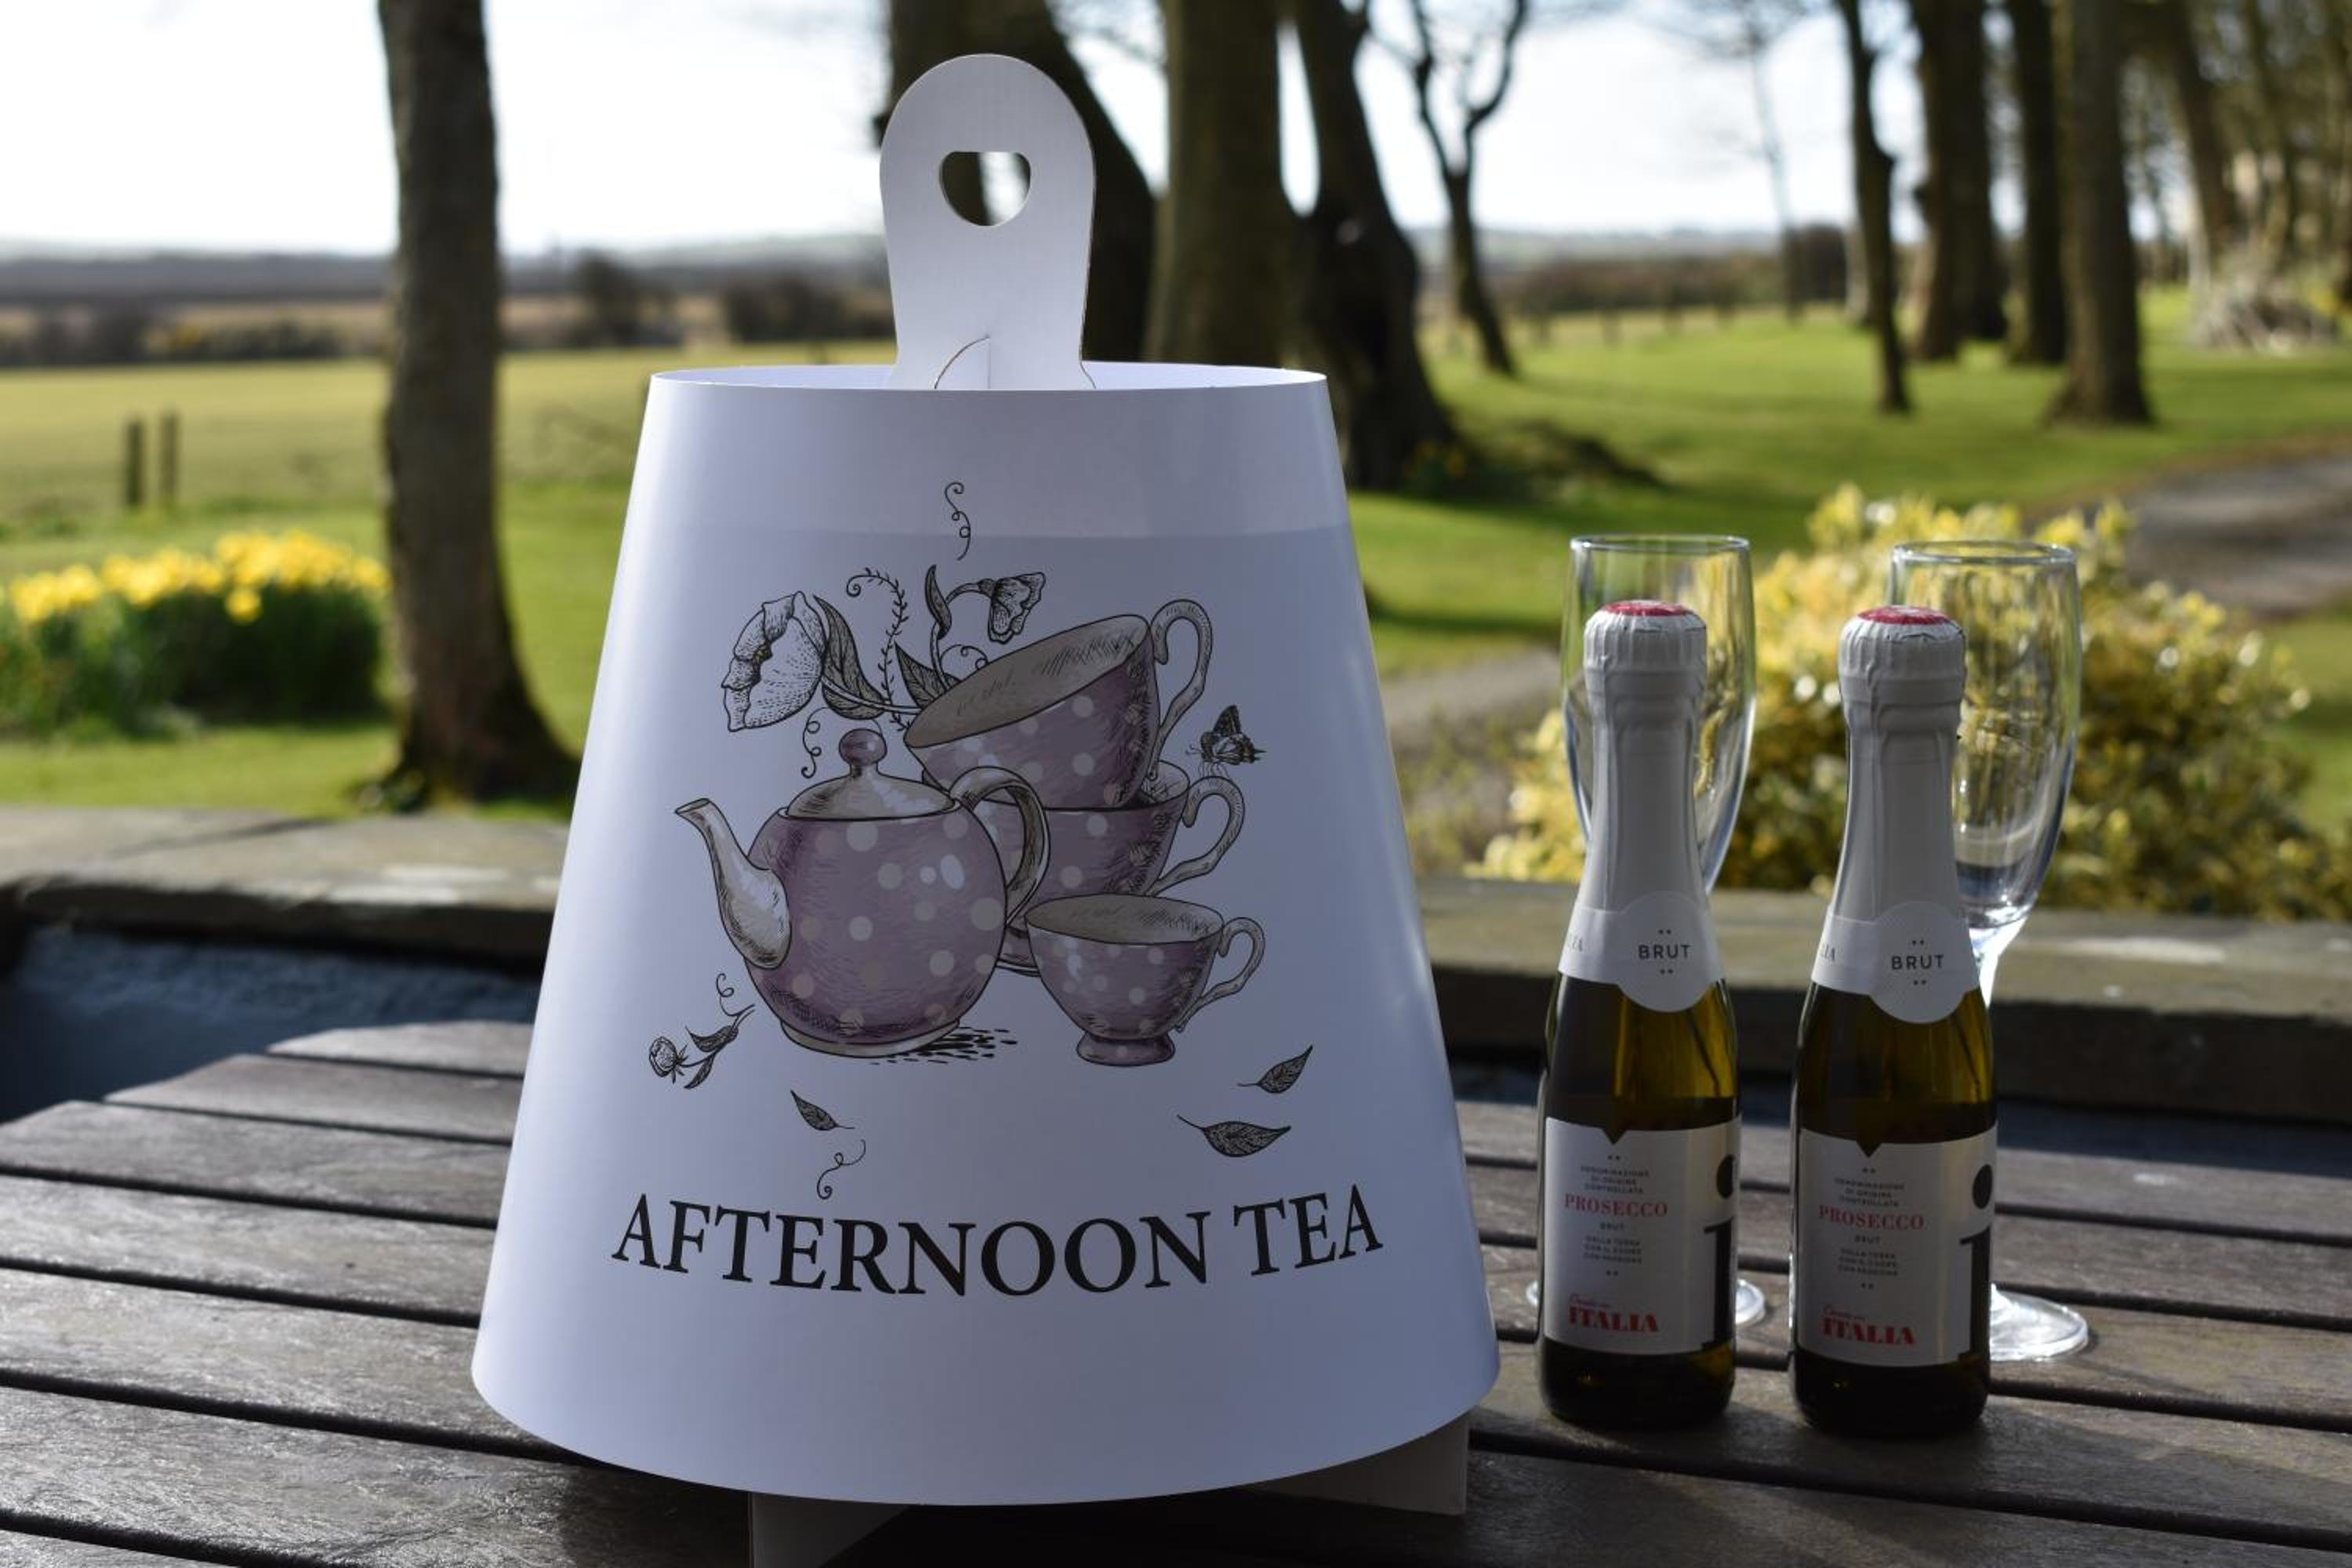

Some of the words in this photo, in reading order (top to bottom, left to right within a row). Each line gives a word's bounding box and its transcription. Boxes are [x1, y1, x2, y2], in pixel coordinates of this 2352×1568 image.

[1639, 943, 1691, 960] BRUT
[1891, 953, 1944, 970] BRUT
[1564, 1193, 1669, 1217] PROSECCO
[1818, 1203, 1925, 1229] PROSECCO
[612, 1192, 1212, 1298] AFTERNOON
[1231, 1184, 1385, 1278] TEA
[1569, 1305, 1659, 1333] ITALIA
[1824, 1317, 1916, 1345] ITALIA
